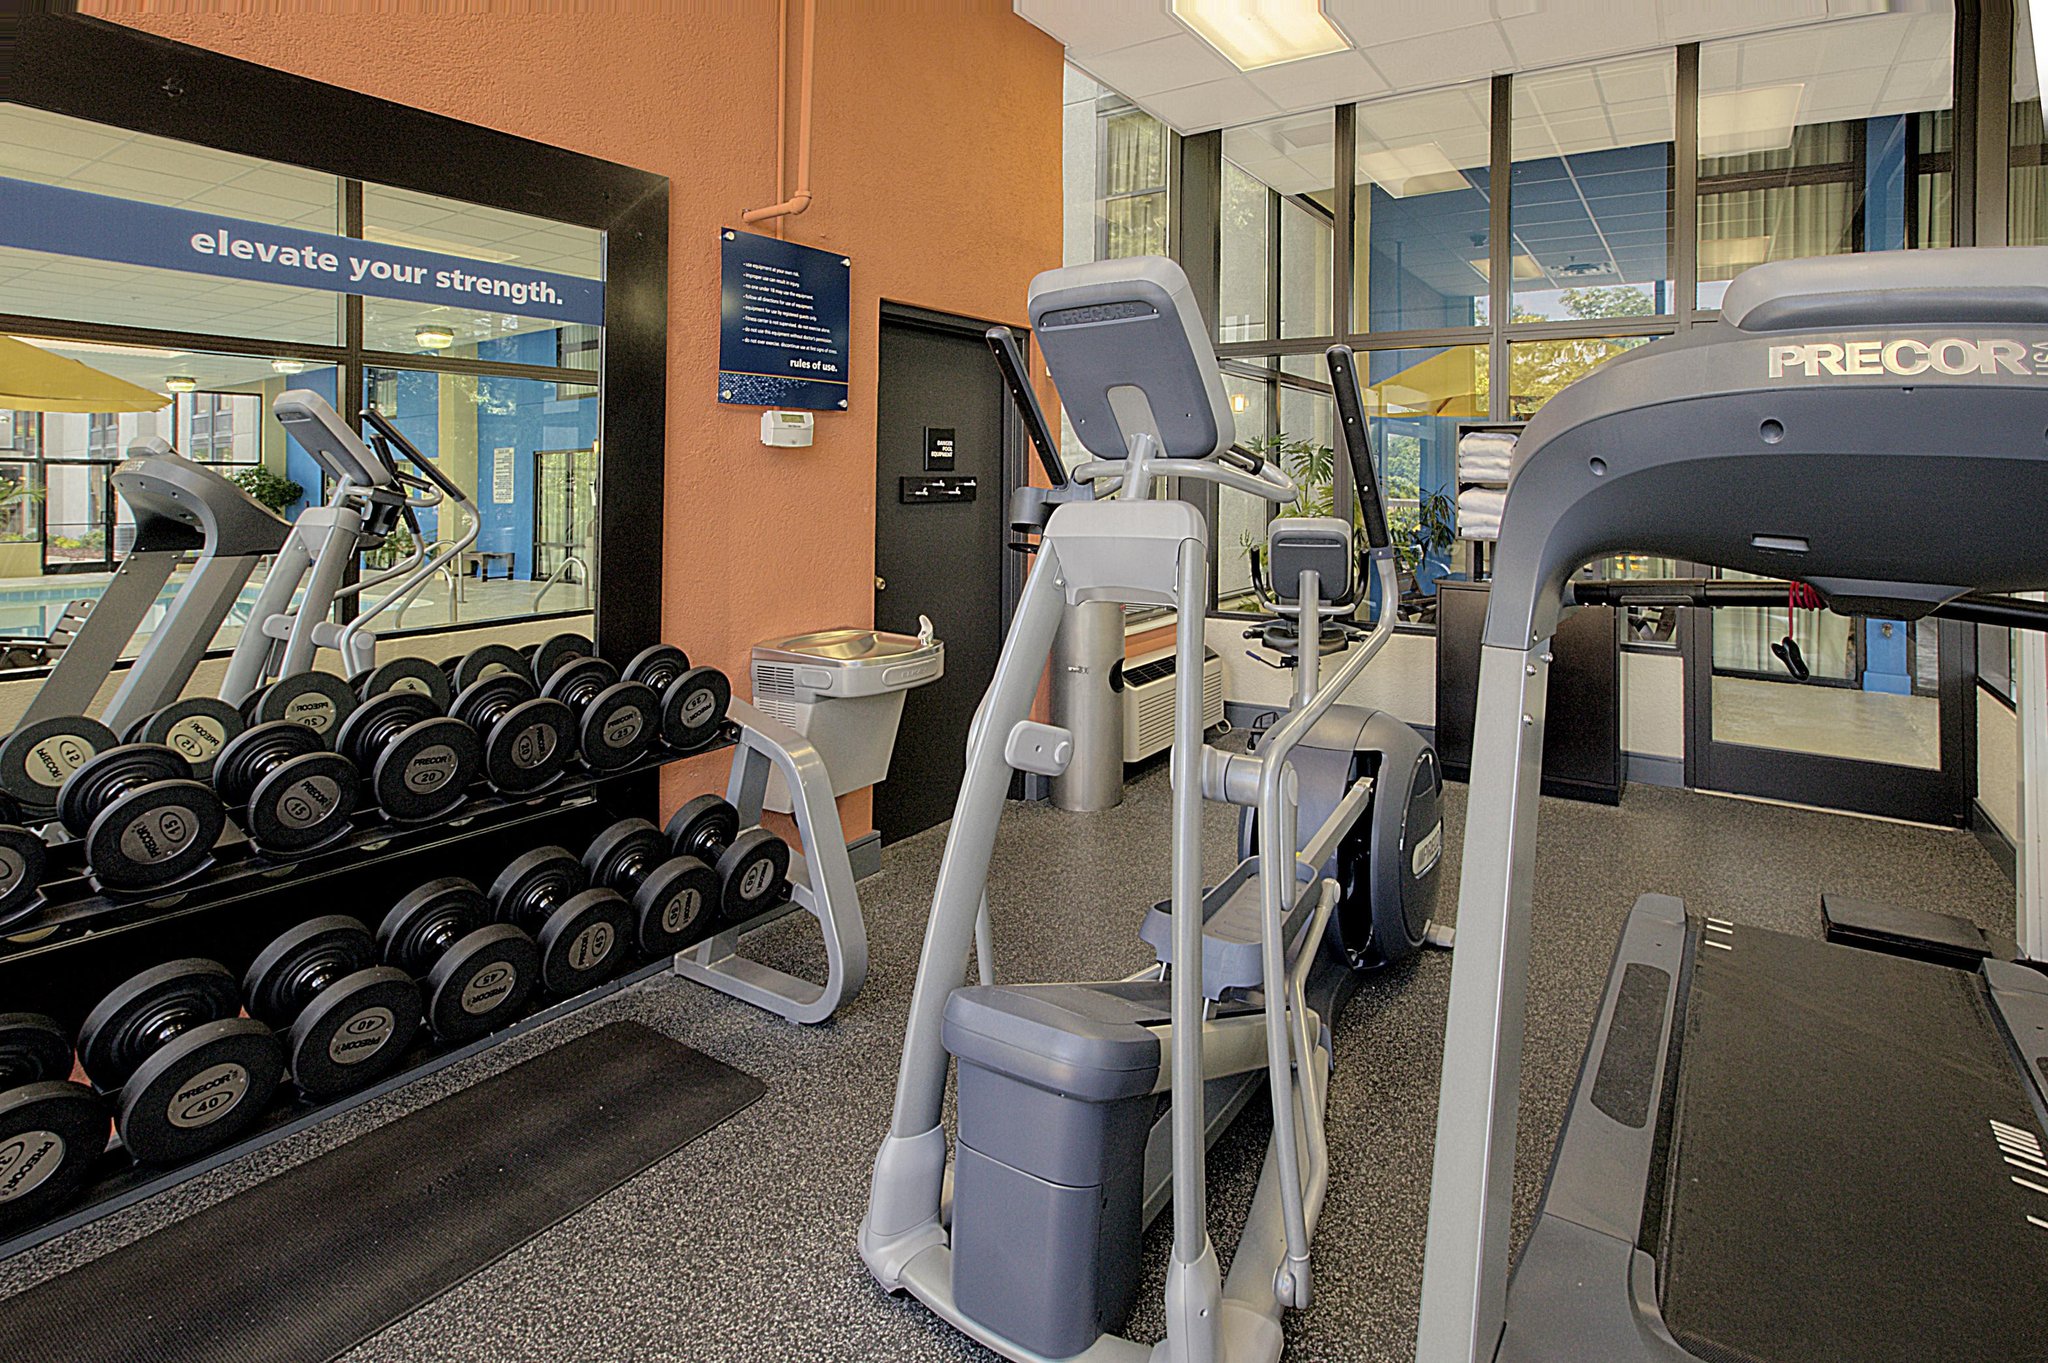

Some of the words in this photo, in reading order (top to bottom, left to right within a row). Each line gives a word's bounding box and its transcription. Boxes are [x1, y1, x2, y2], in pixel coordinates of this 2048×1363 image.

[190, 228, 339, 272] elevate
[348, 256, 428, 285] your
[435, 268, 563, 305] strength.
[789, 358, 811, 369] rules
[812, 361, 821, 370] of
[822, 364, 838, 372] use.
[1768, 339, 2032, 379] PRECOR
[691, 696, 701, 707] 25
[607, 714, 633, 728] PRECOR
[617, 730, 628, 738] 25
[413, 756, 447, 766] PRECOR
[420, 773, 435, 782] 20
[301, 781, 330, 806] PRECOR
[291, 802, 306, 815] 15
[164, 819, 180, 834] 15
[136, 824, 162, 859] PRECOR
[483, 973, 498, 985] 45
[472, 985, 507, 1004] PRECOR
[357, 1019, 376, 1030] 40
[341, 1036, 382, 1051] PRECOR
[177, 1076, 230, 1103] PRECOR
[197, 1098, 219, 1112] 40
[2, 1141, 56, 1189] PRECOR
